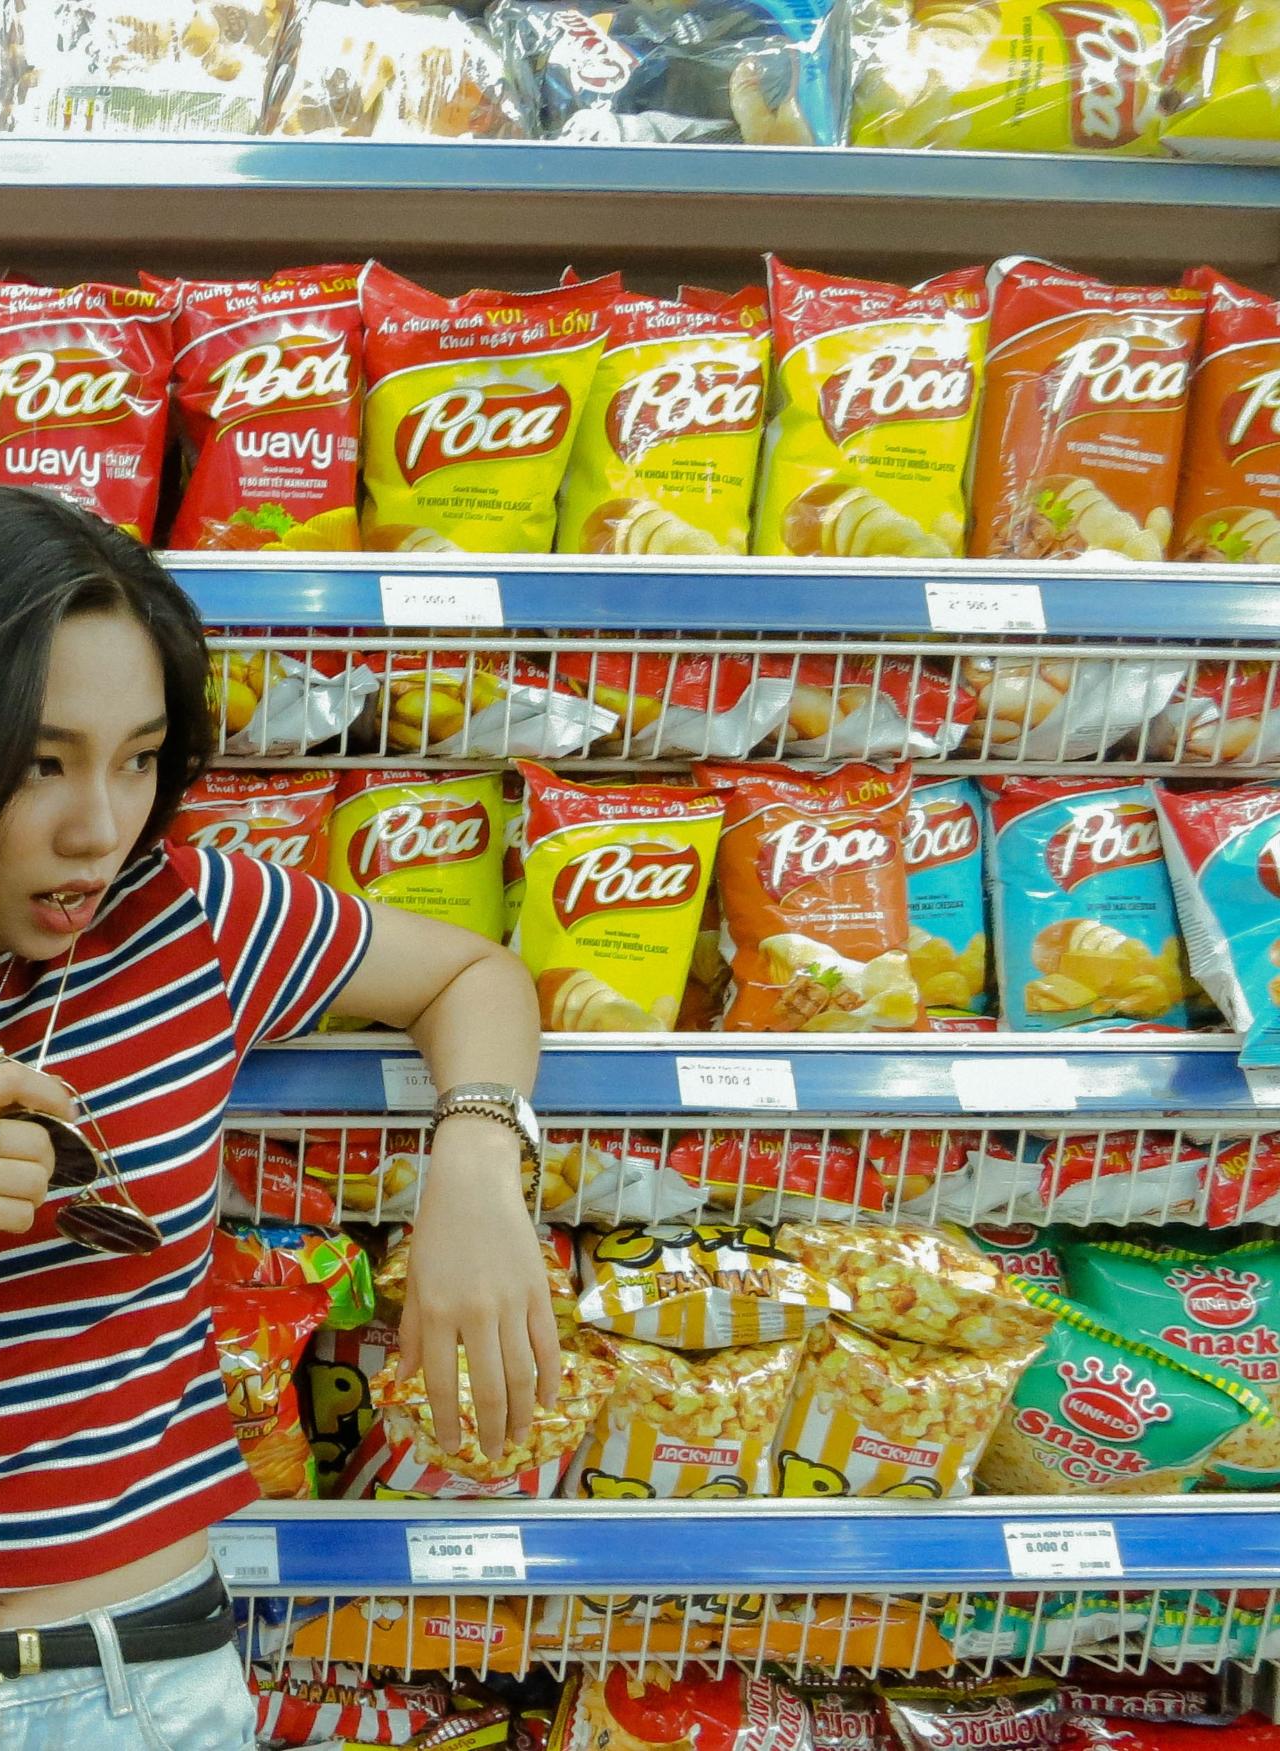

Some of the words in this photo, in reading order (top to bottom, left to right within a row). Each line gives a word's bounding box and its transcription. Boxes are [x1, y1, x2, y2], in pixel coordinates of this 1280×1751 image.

[439, 334, 474, 349] Khui
[1051, 338, 1188, 412] Poca
[209, 343, 351, 418] Poca
[618, 362, 758, 448] Poca
[832, 347, 968, 434] Poca
[235, 428, 334, 469] wavy
[406, 387, 564, 468] Poca
[5, 446, 100, 487] wavy
[427, 496, 449, 507] KHOAI
[361, 805, 483, 875] Poca
[761, 820, 889, 887] Poca
[565, 844, 694, 914] Poca
[1000, 1248, 1060, 1277] nack
[1014, 1408, 1147, 1475] Snack
